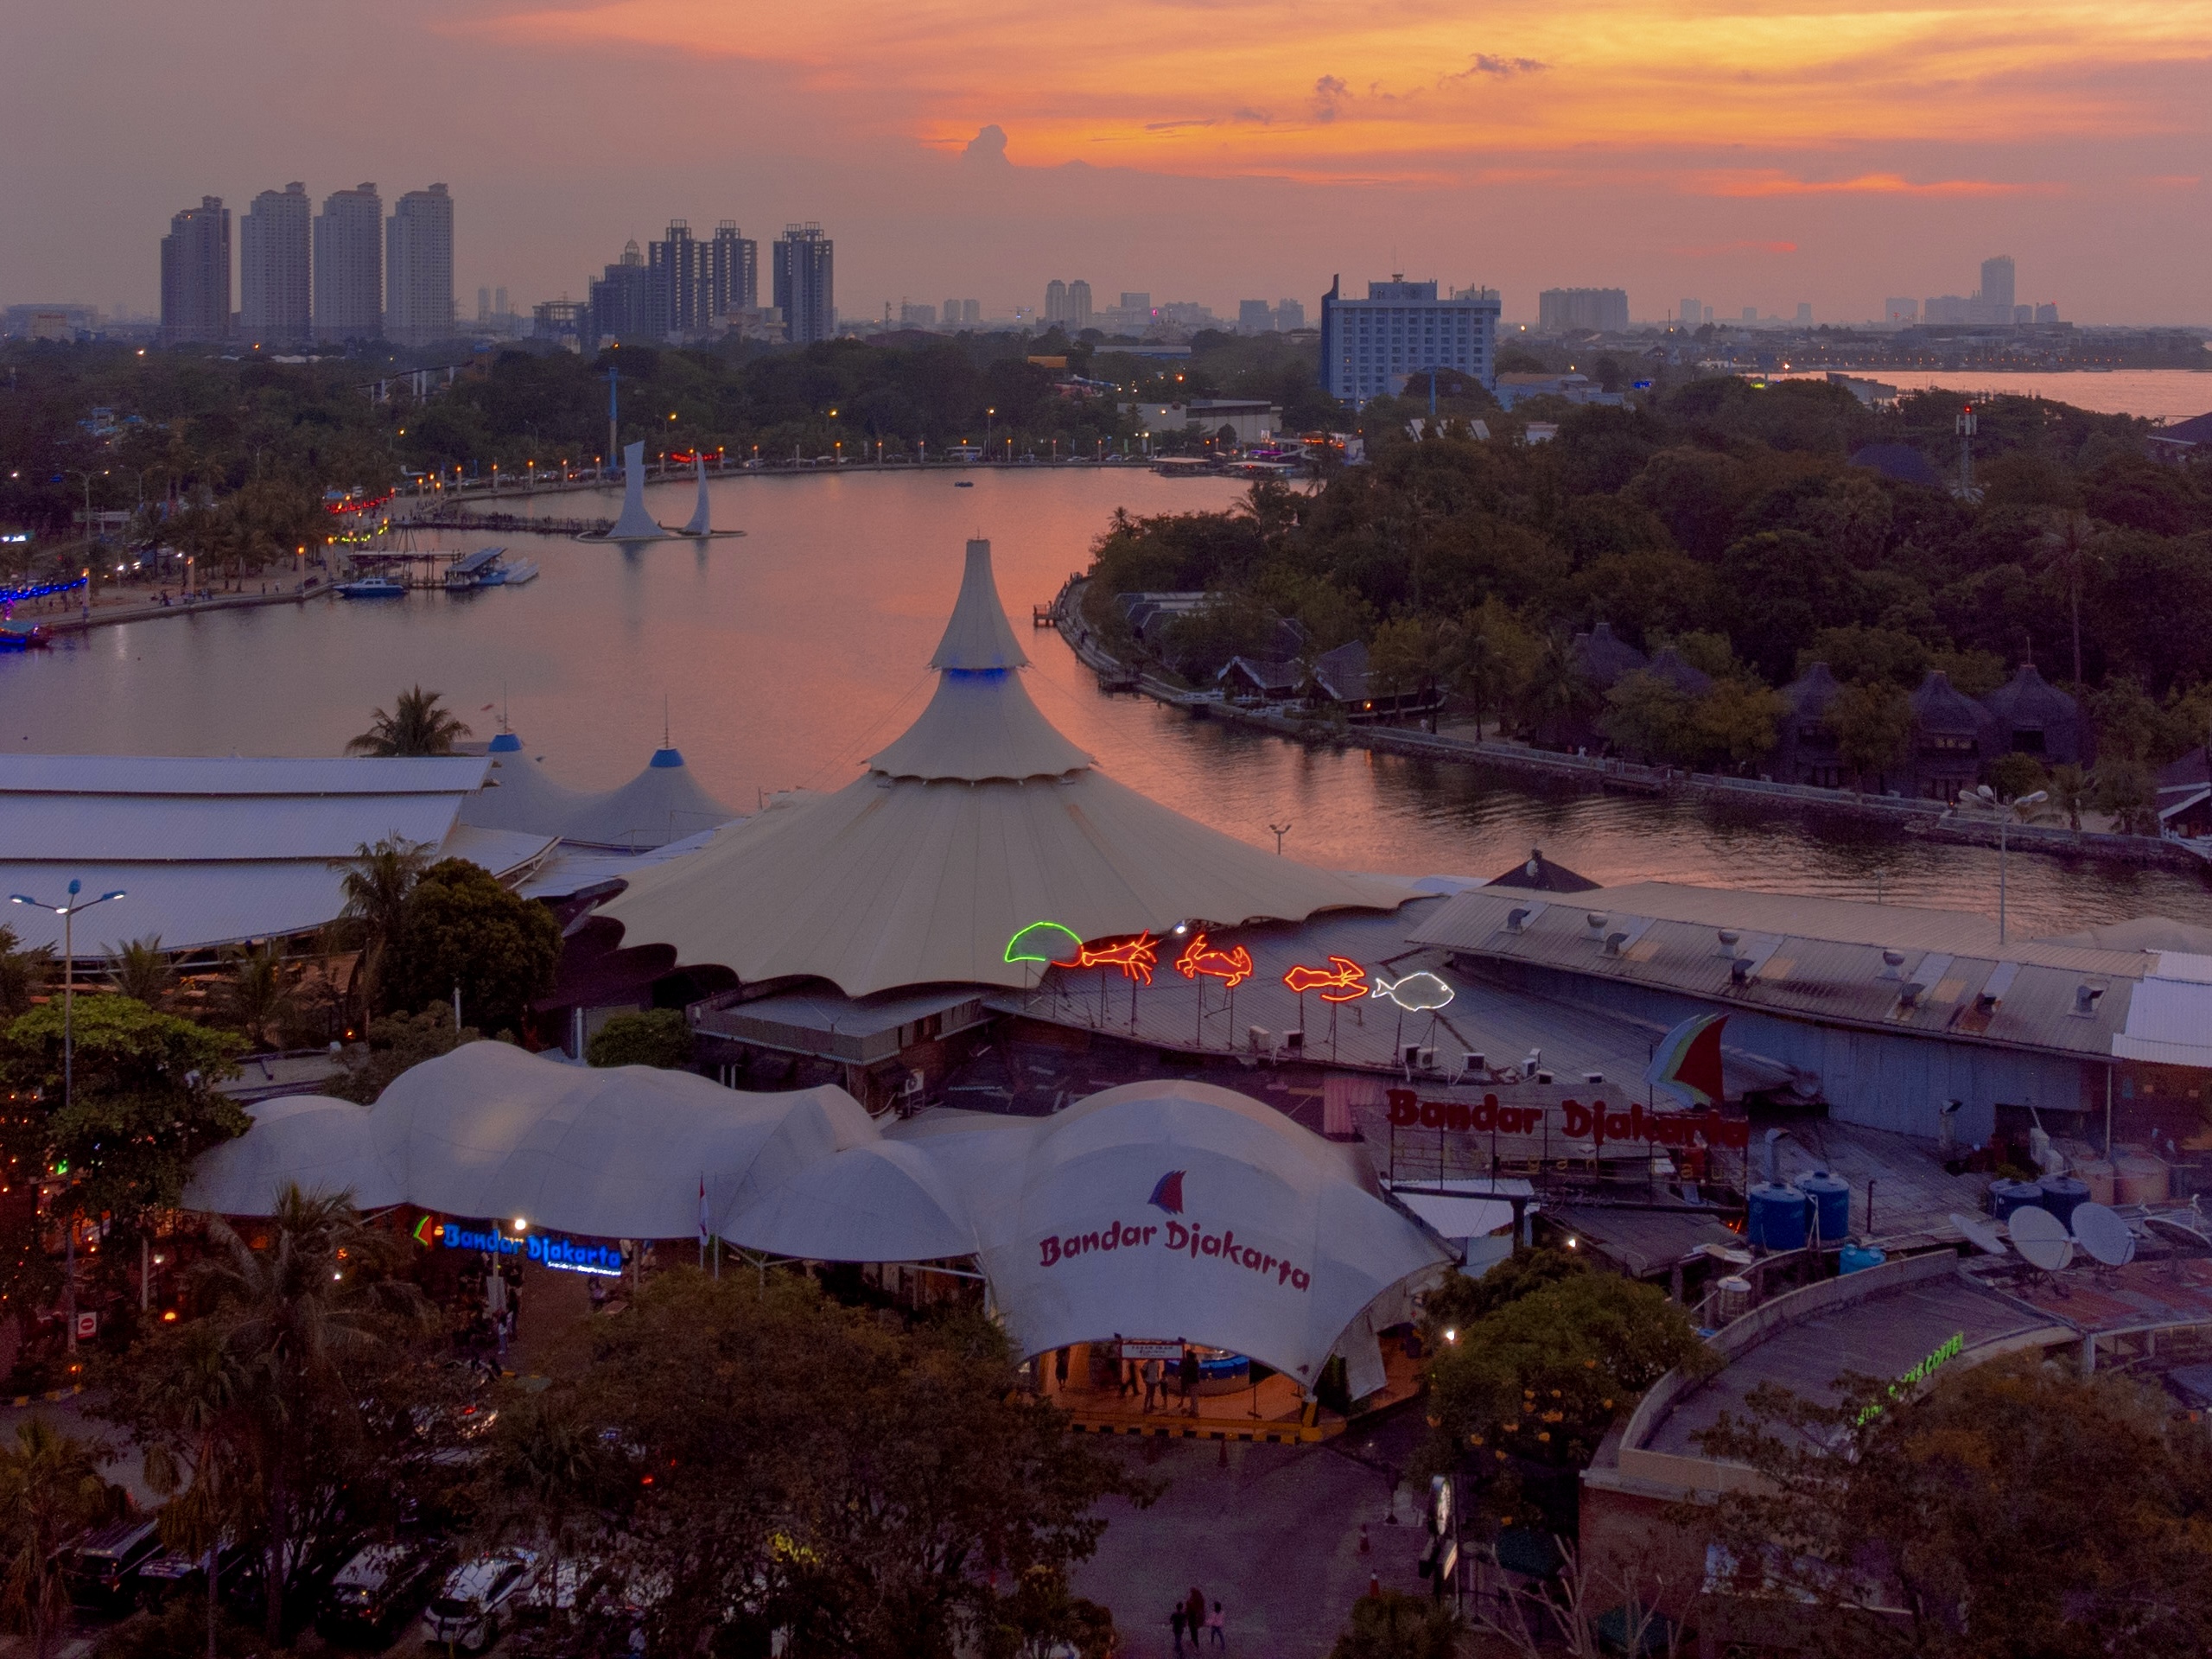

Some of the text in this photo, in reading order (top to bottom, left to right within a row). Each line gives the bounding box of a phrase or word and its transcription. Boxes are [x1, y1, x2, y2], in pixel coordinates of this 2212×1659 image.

[1386, 1089, 1749, 1148] Bandar Djakarta
[442, 1223, 522, 1255] Bandar
[526, 1234, 622, 1268] Djakarta
[1039, 1220, 1311, 1292] Bandar Djakarta
